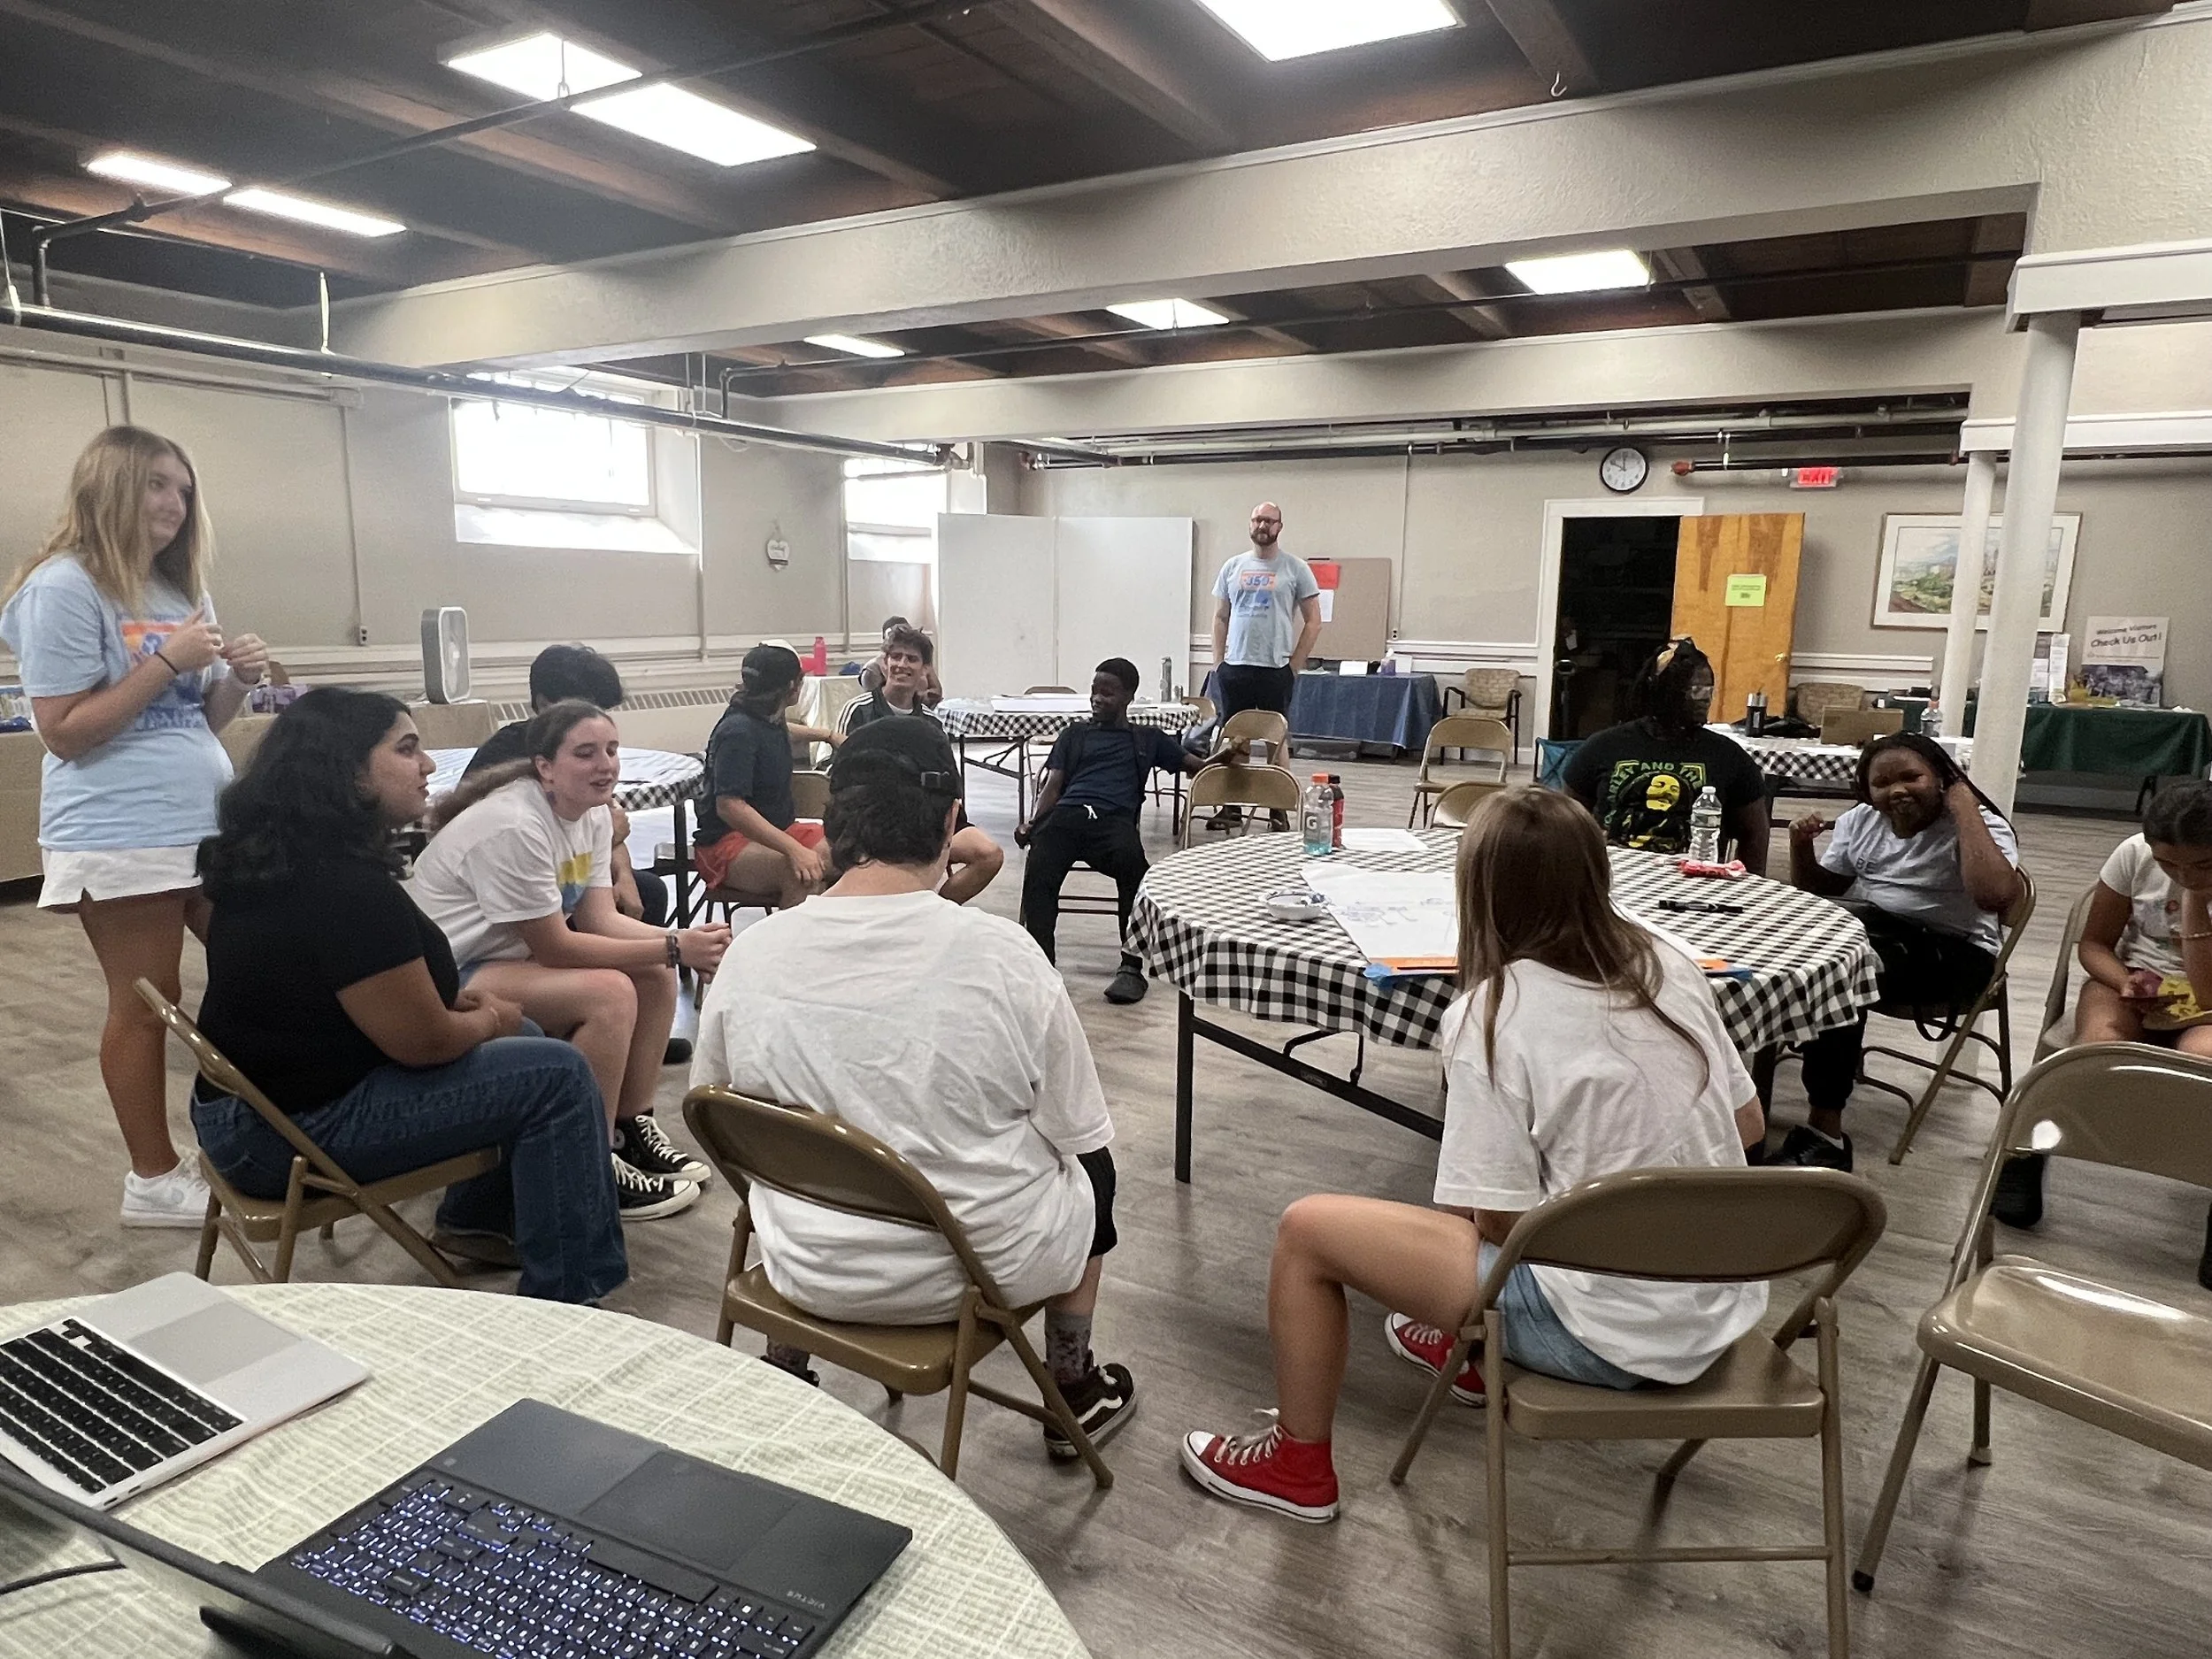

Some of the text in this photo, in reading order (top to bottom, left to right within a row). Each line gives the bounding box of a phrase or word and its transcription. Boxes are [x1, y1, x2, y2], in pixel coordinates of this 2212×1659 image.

[1799, 468, 1835, 483] EXIT
[2090, 637, 2120, 648] Check
[2123, 635, 2136, 644] Us
[1640, 762, 1675, 772] AND
[1306, 815, 1317, 830] G
